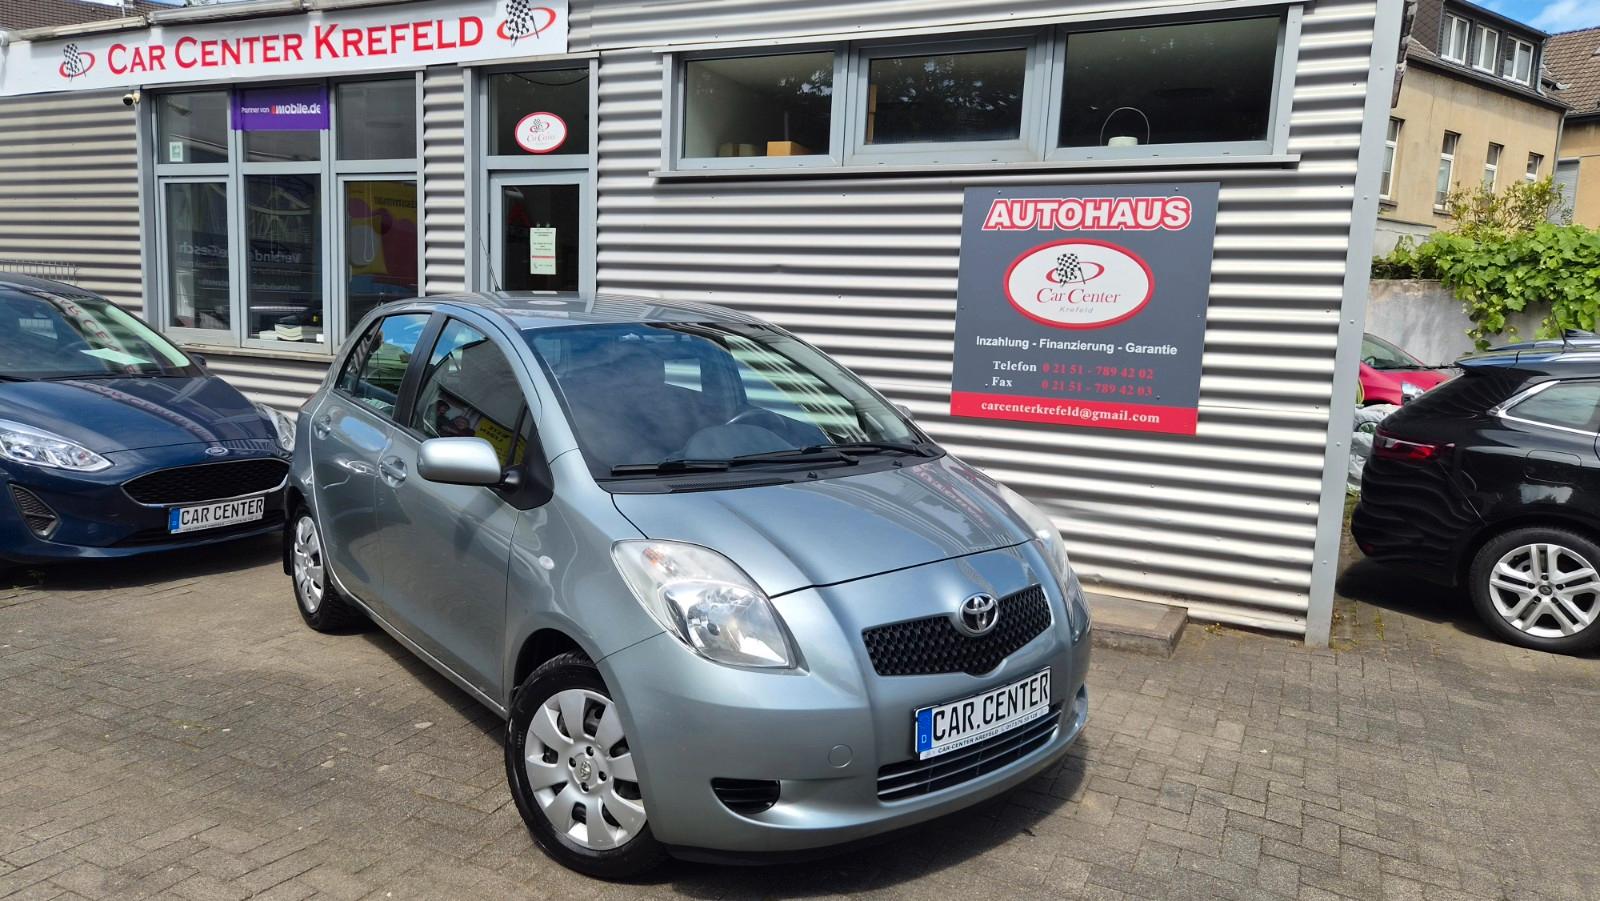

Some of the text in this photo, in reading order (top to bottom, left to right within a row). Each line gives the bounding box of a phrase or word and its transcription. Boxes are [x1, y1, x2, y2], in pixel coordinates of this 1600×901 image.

[108, 16, 484, 74] CAR CENTER KREFELD
[982, 196, 1192, 231] AUTOHAUS
[1037, 287, 1121, 304] Car Center
[976, 335, 1029, 350] Inzahlung
[1039, 338, 1114, 354] Finanzierung
[1125, 342, 1178, 355] Garantie
[992, 360, 1037, 372] Telefon
[1042, 362, 1050, 374] 0
[1053, 363, 1066, 374] 21
[1095, 365, 1118, 377] 789
[1120, 367, 1136, 378] 42
[1138, 368, 1153, 380] 02
[991, 376, 1013, 387] Fax
[1041, 379, 1049, 390] 0
[1094, 383, 1117, 394] 789
[981, 400, 1160, 424] carcenterkrefeld@gmail.com
[181, 507, 210, 526] CAR
[213, 498, 264, 521] CENTER
[921, 734, 927, 744] D
